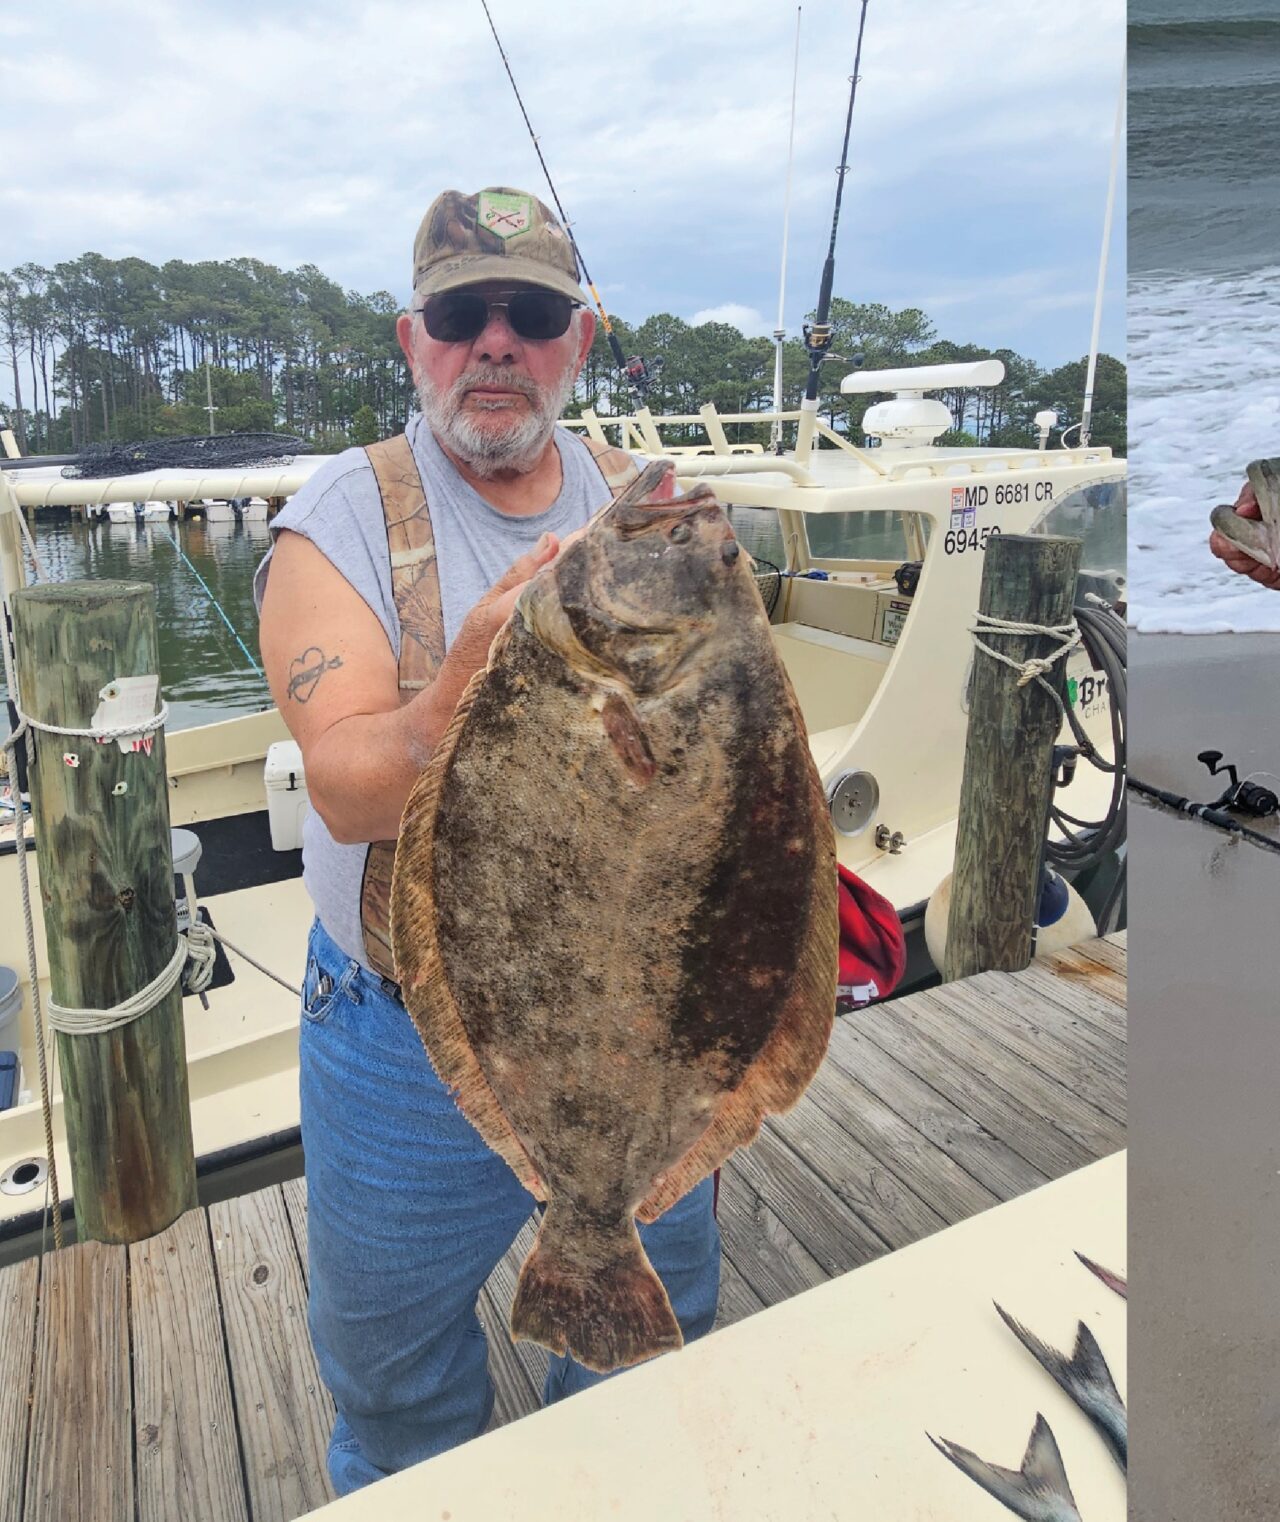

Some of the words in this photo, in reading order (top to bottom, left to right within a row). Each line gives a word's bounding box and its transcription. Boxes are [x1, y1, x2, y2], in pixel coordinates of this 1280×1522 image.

[965, 486, 988, 507] MD
[995, 483, 1029, 504] 6681
[1035, 481, 1053, 500] CR
